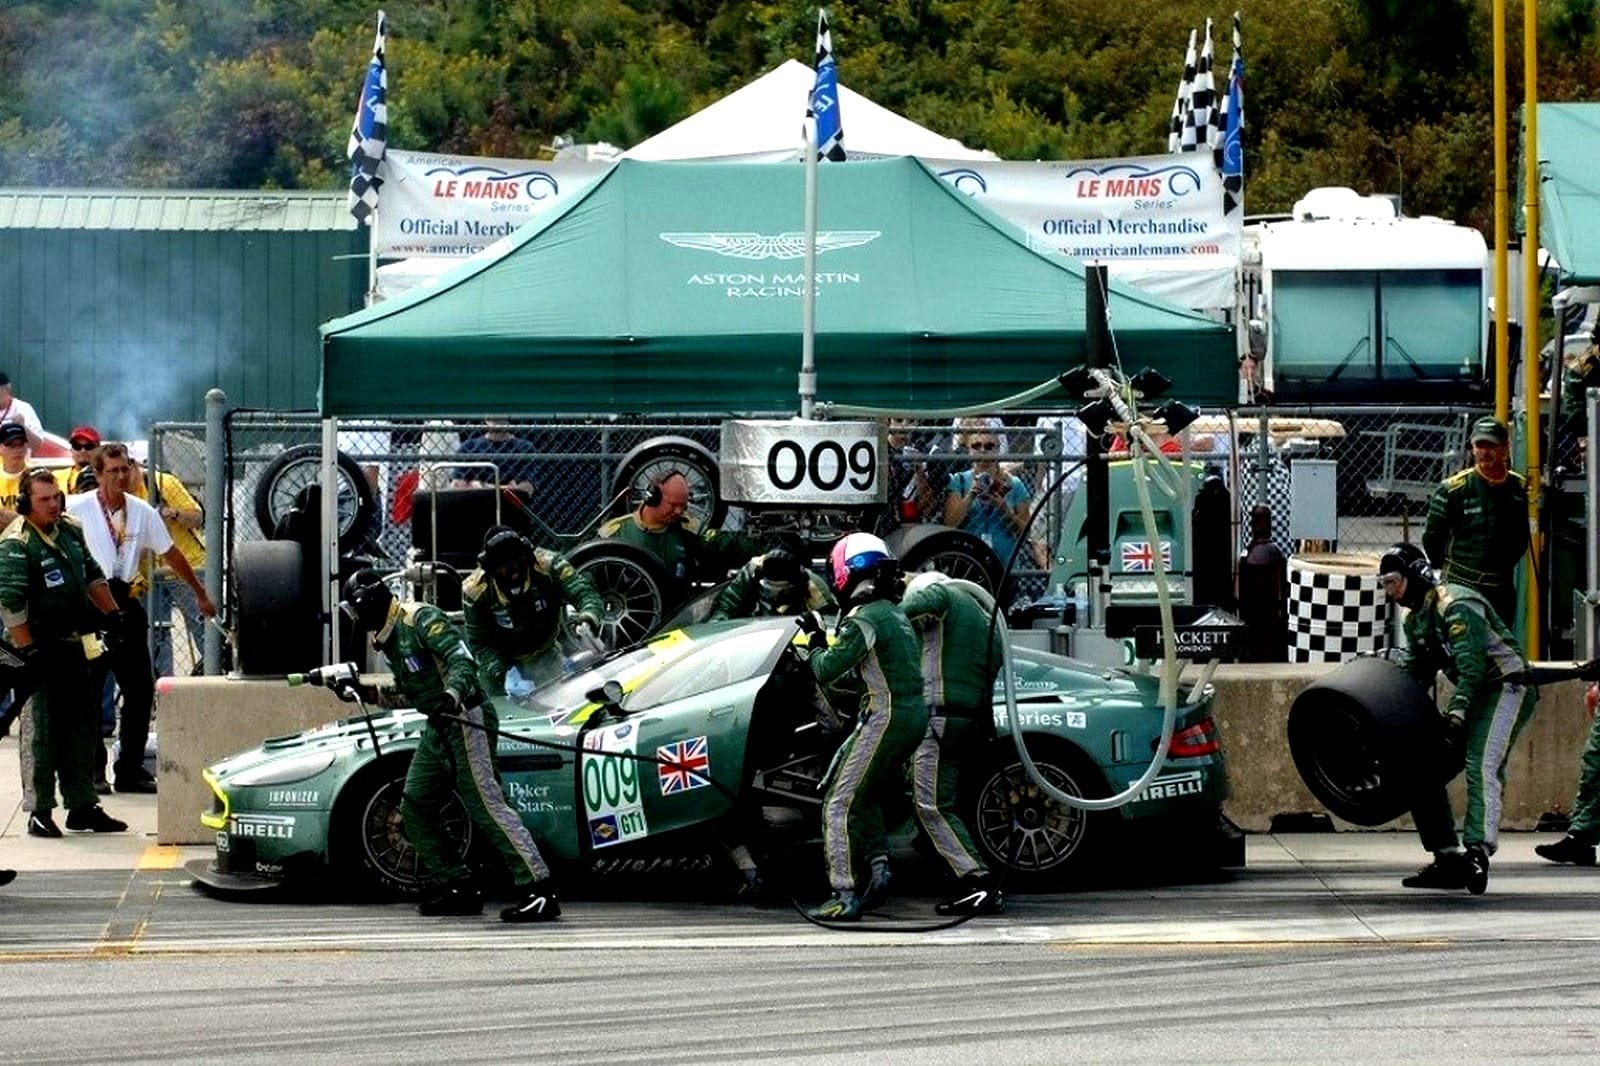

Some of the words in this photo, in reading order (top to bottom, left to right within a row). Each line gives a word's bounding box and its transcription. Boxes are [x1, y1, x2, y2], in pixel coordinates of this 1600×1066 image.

[434, 180, 457, 197] LE
[463, 181, 520, 199] MANS
[1077, 180, 1100, 197] LE
[1105, 179, 1162, 198] MANS
[491, 201, 530, 213] Series
[1134, 199, 1173, 211] Series
[400, 218, 458, 235] Official
[465, 220, 522, 236] Merch
[1043, 219, 1101, 235] Official
[1107, 218, 1208, 235] Merchandise
[687, 273, 764, 285] ASTON
[767, 440, 876, 491] 009
[584, 748, 638, 812] 009
[620, 812, 645, 835] GT1
